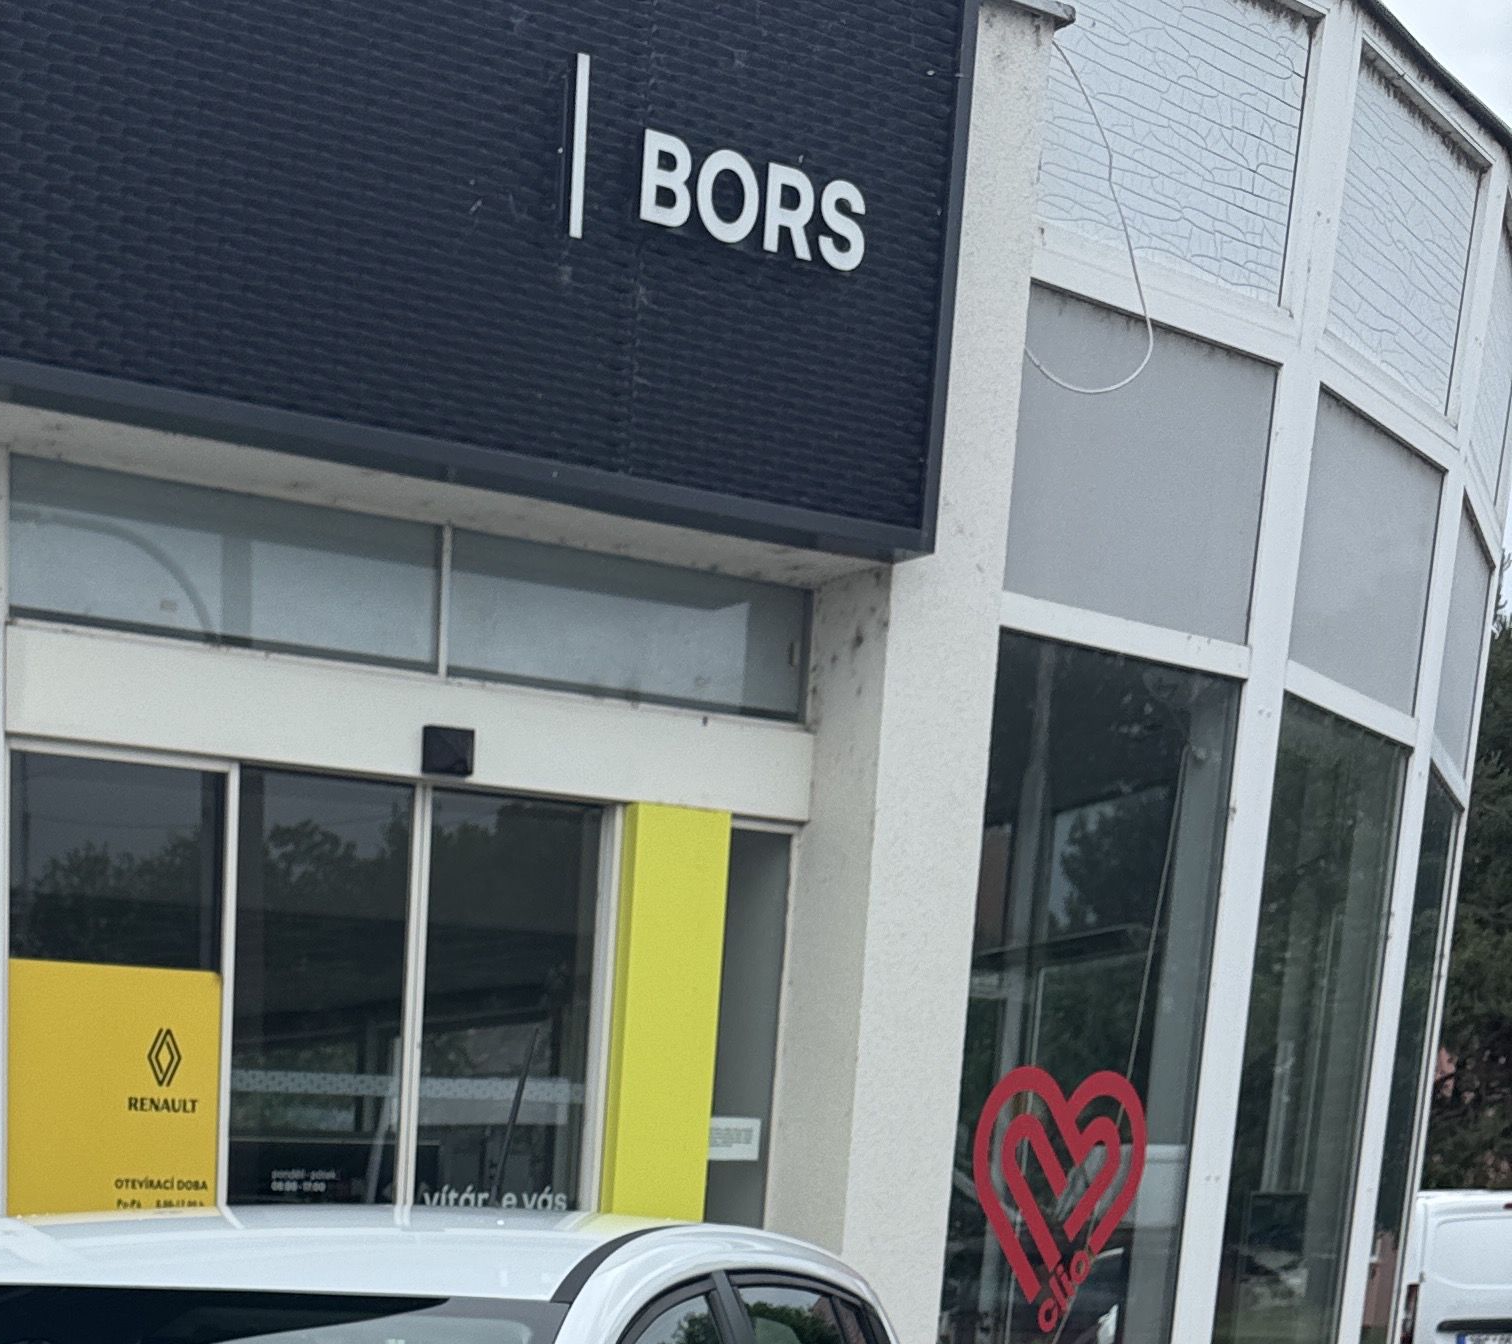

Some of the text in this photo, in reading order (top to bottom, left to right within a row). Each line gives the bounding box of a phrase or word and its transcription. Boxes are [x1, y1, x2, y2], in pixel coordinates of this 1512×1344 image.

[640, 129, 866, 272] BORS
[128, 1097, 198, 1113] RENAULT
[114, 1176, 208, 1191] OTEVÍRACÍ DOBA
[522, 1186, 568, 1211] vás
[1038, 1251, 1090, 1333] clio
